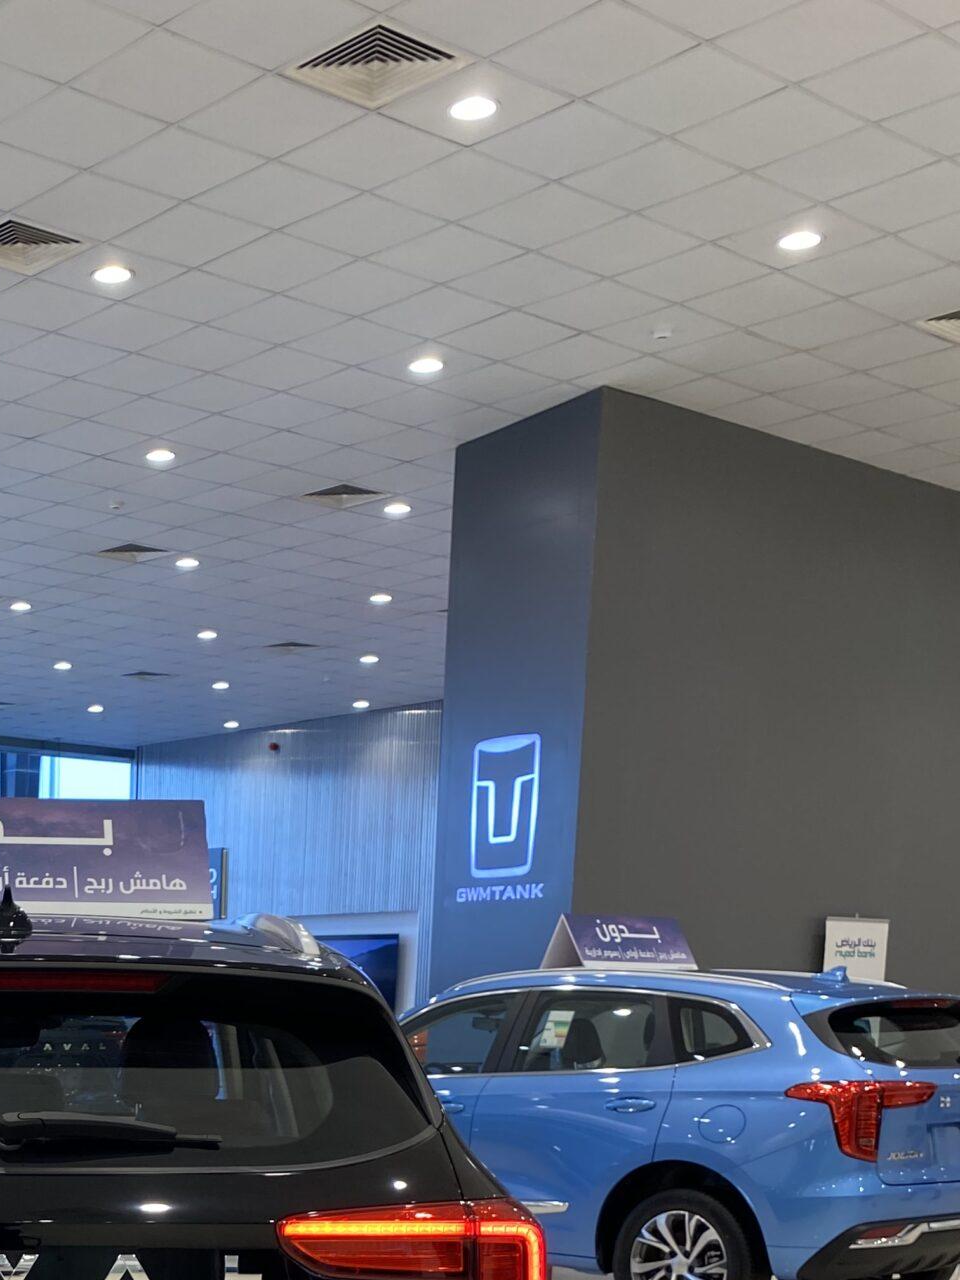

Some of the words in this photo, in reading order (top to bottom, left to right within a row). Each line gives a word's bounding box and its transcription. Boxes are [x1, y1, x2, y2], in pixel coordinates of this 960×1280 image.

[15, 872, 68, 889] دفعة
[84, 873, 114, 894] ربح
[119, 870, 188, 894] هامش
[595, 919, 662, 944] بدون
